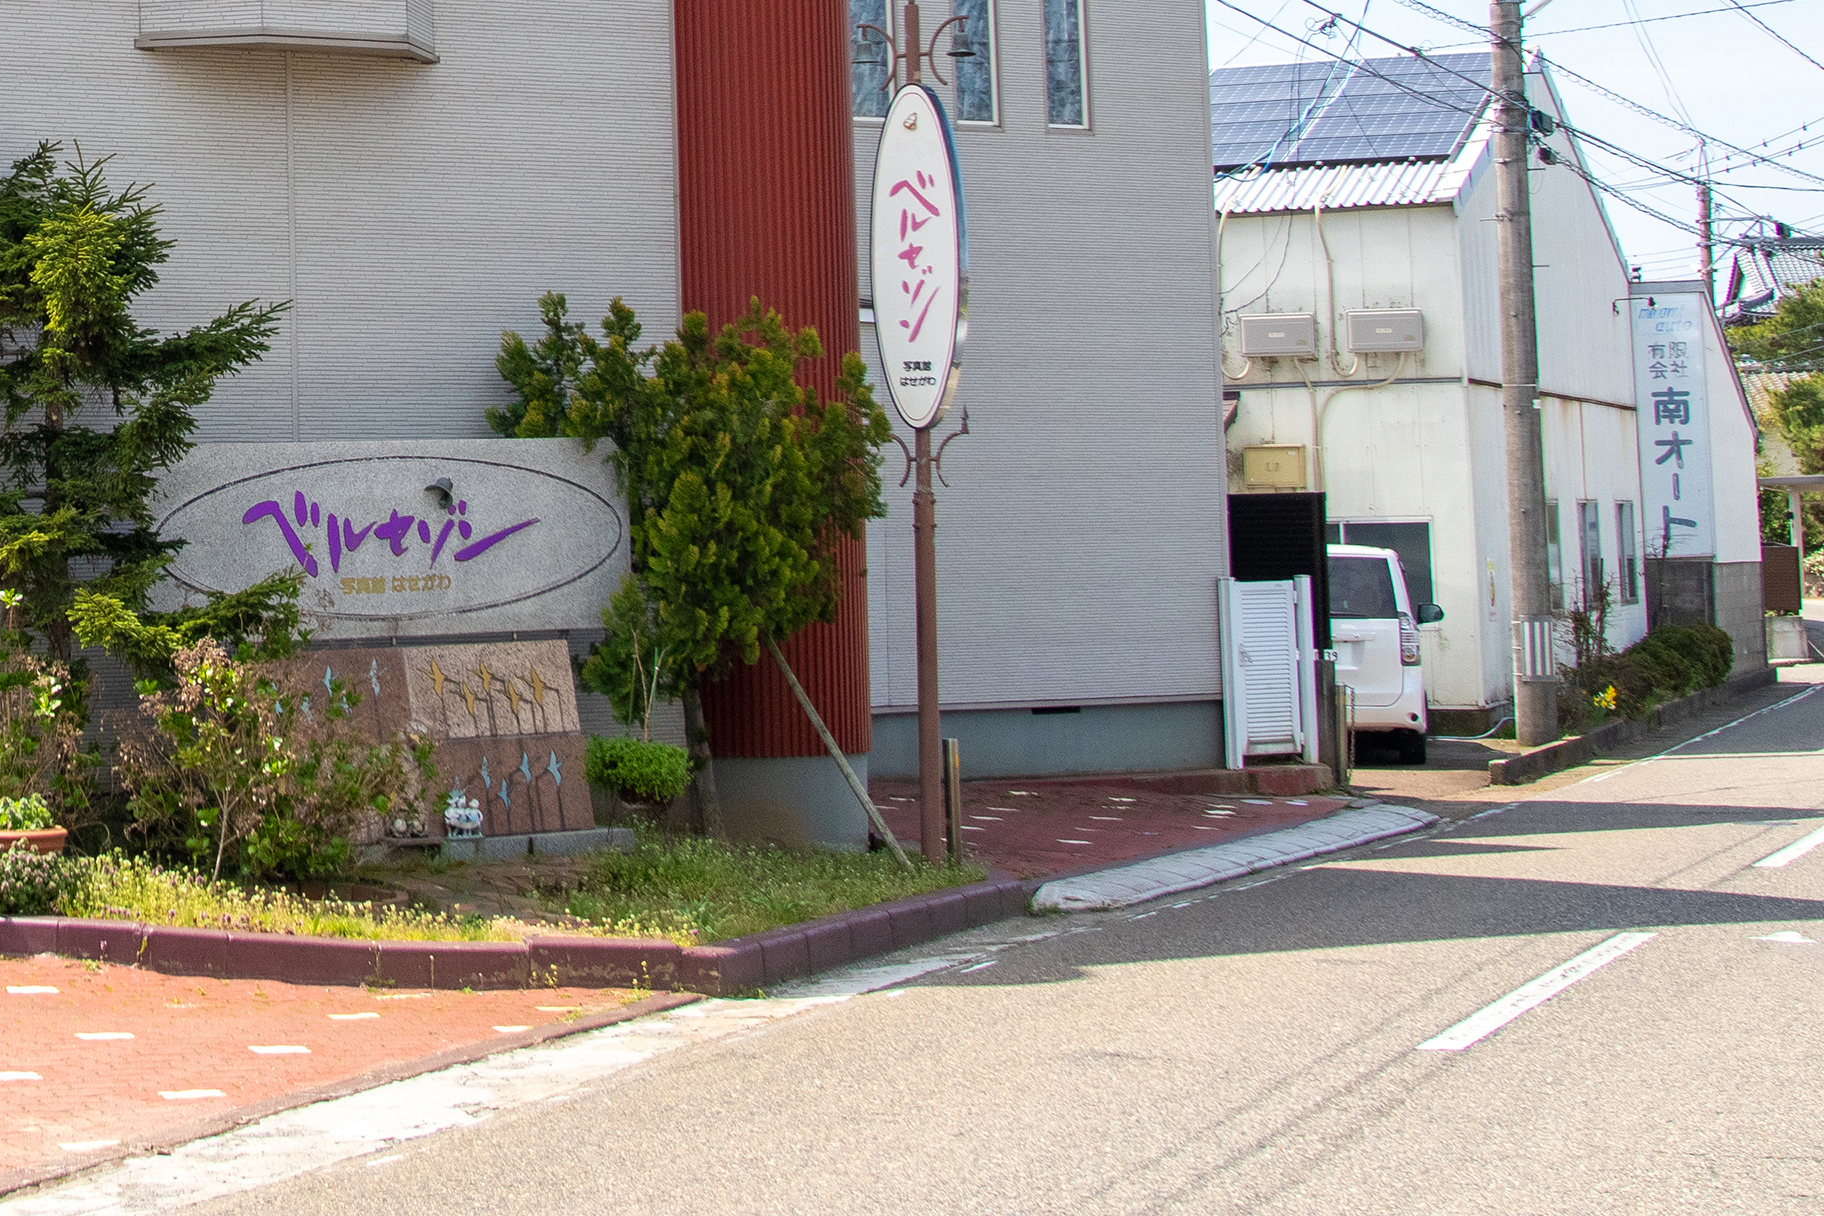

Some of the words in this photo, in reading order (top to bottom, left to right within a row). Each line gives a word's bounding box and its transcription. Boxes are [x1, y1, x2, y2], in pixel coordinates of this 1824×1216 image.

[889, 170, 940, 343] ベルセゾン
[242, 490, 541, 577] ベルセゾン
[1651, 386, 1698, 552] 南オート
